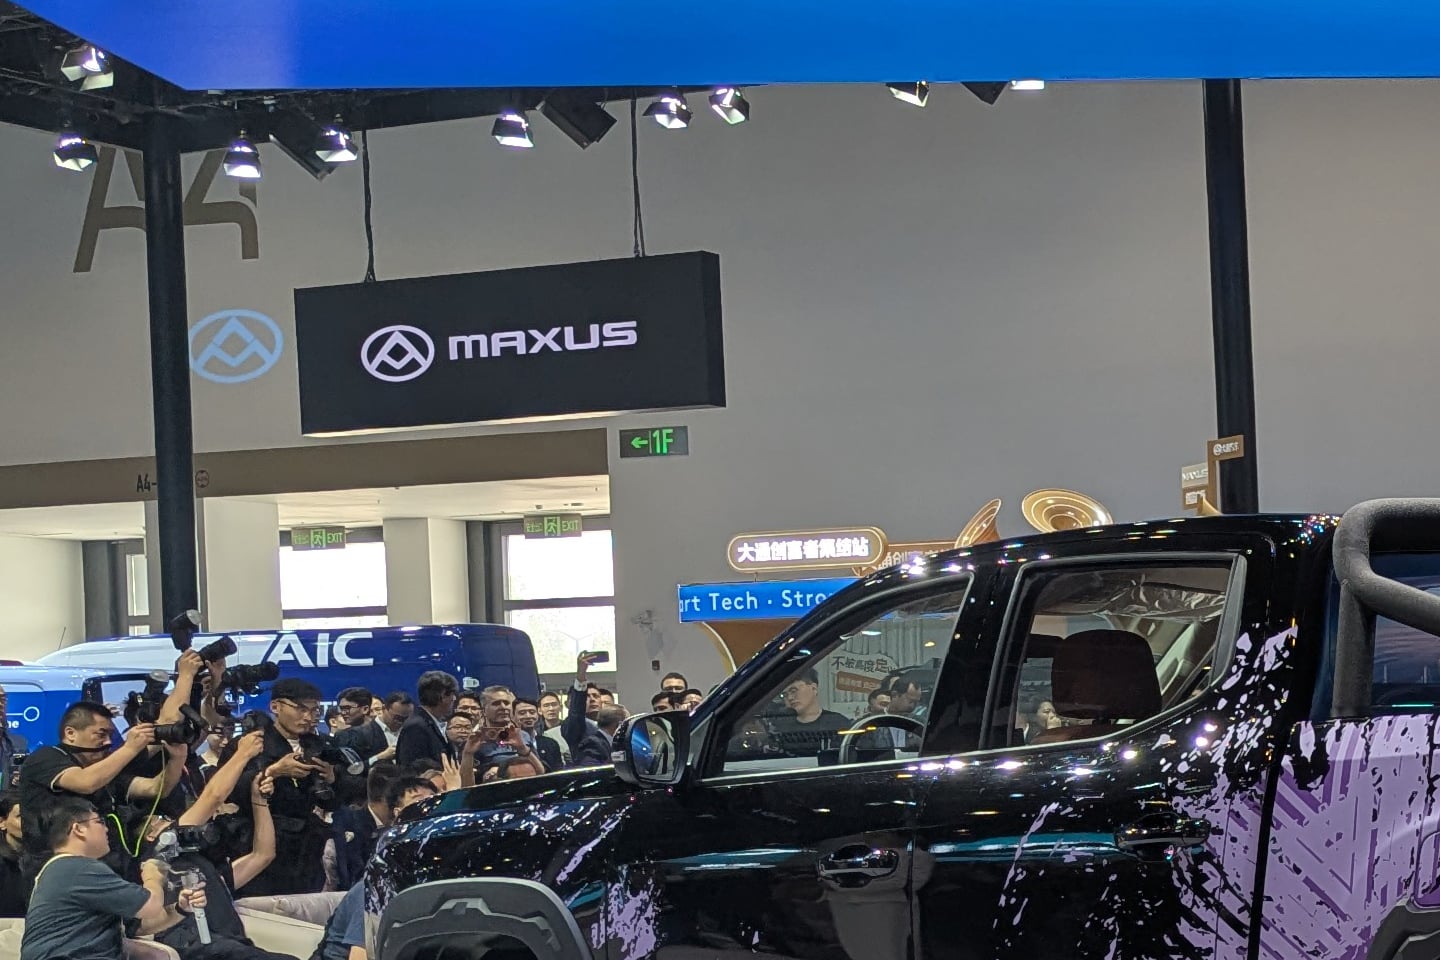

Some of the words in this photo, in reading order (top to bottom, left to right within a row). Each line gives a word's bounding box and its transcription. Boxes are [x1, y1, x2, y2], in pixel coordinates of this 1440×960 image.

[448, 320, 638, 361] MAXUS
[652, 428, 674, 454] 1F
[708, 590, 759, 612] Tech
[781, 588, 834, 609] Stro
